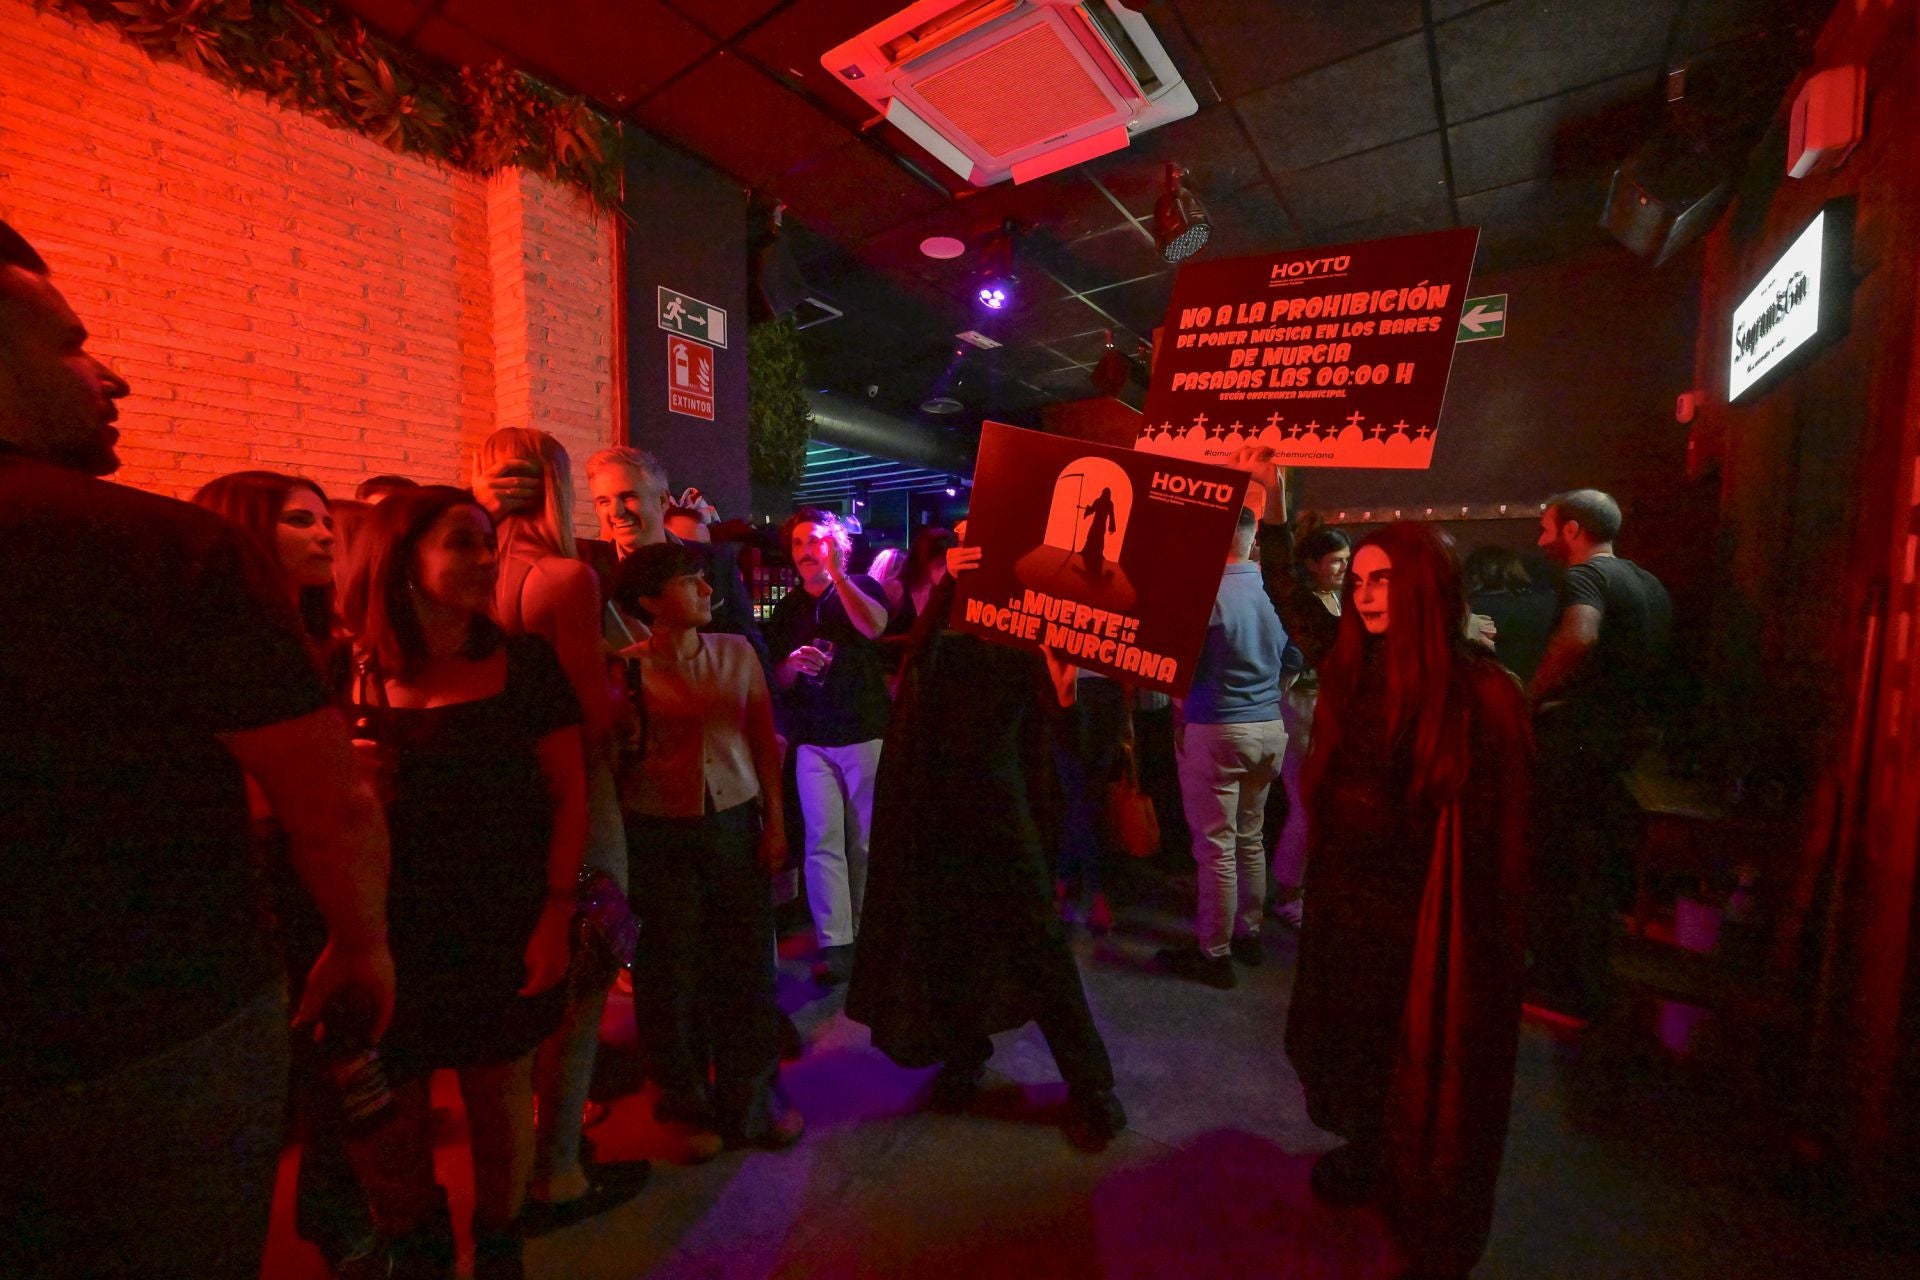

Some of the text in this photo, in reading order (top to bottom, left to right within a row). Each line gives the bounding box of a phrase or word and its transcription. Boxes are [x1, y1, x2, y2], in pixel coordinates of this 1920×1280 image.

[1180, 280, 1451, 330] NO A LA PROHIBICIÓN
[1177, 316, 1442, 349] DE PONER MÚSICA EN LOS BARES
[1230, 343, 1352, 368] DE MURCIA
[1172, 363, 1415, 391] PASADAS LAS 00:00 H
[672, 394, 711, 413] EXTINTOR
[1246, 390, 1297, 400] ORDENANZA
[1297, 389, 1347, 399] MUNICIPAL
[1009, 589, 1140, 638] LA MUERTE DE
[965, 598, 1178, 683] NOCHE MURCIANA
[1121, 630, 1136, 643] LA
